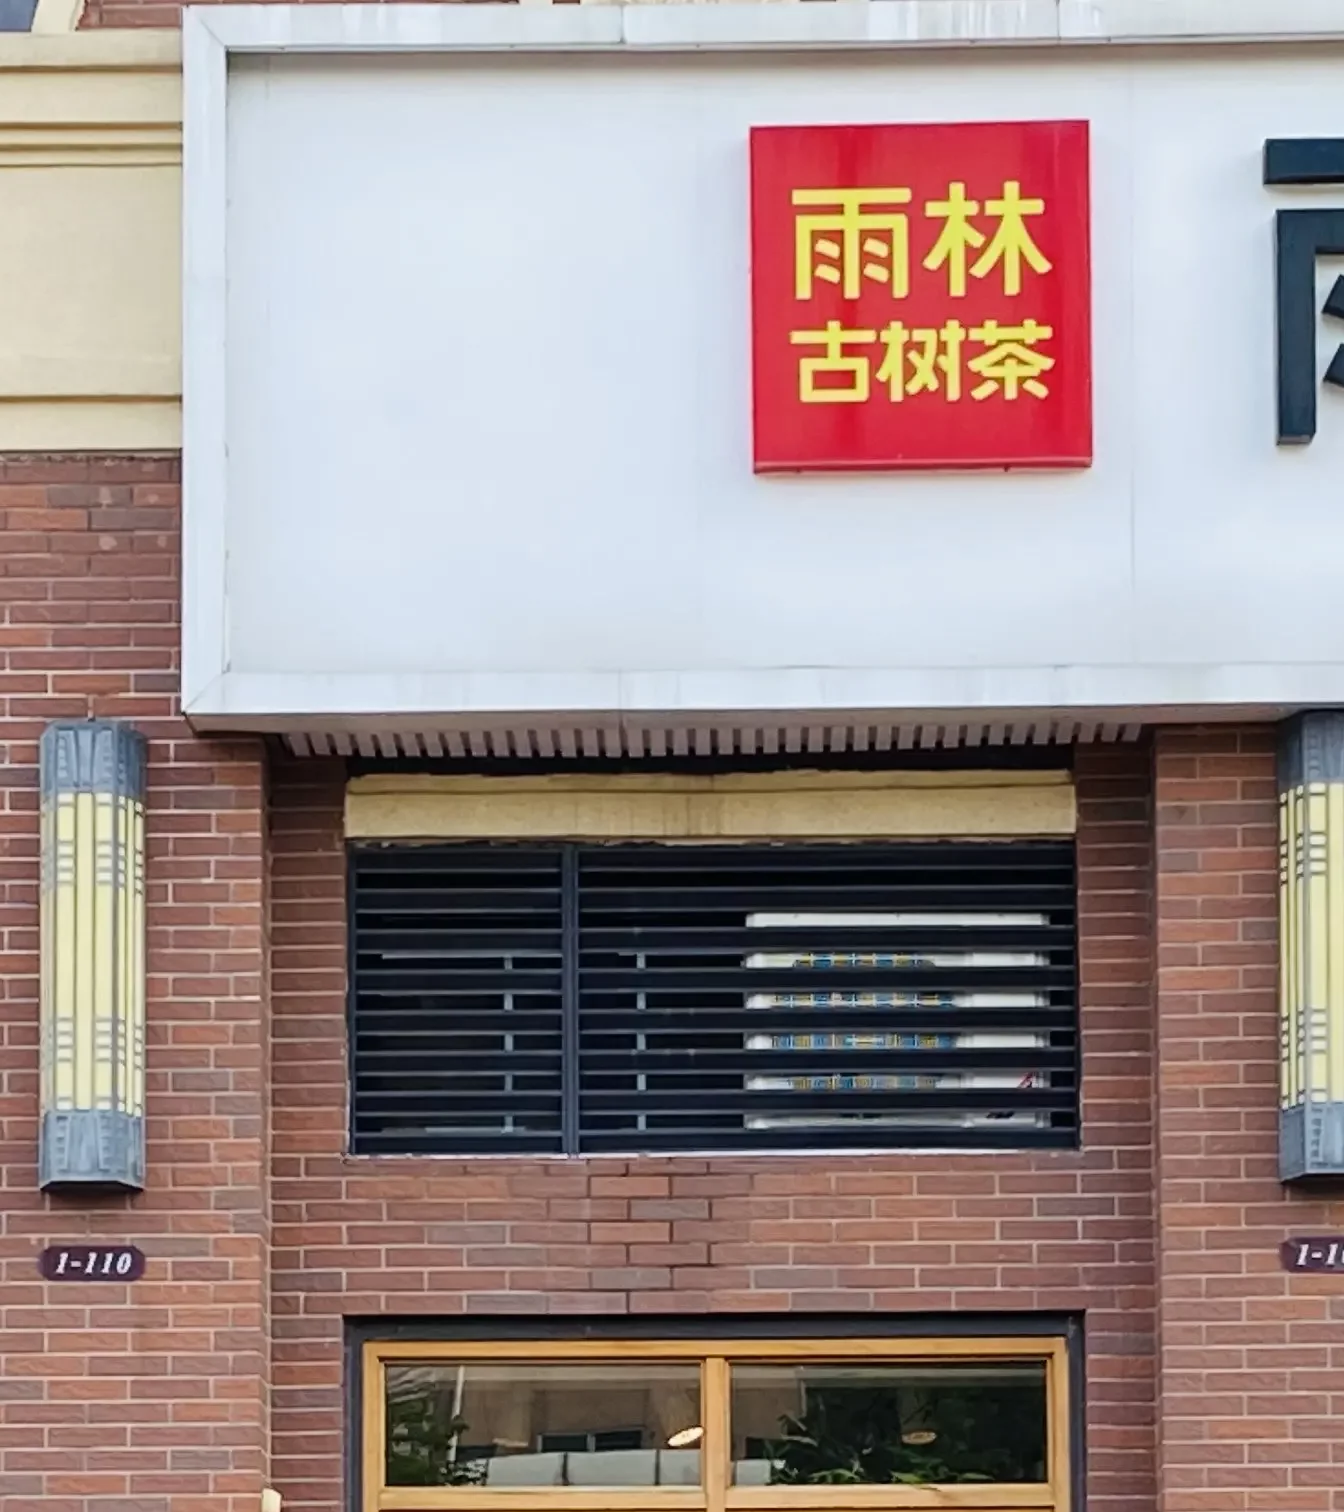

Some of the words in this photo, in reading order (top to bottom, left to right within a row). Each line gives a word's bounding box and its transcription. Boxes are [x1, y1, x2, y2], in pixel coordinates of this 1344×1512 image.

[791, 181, 1053, 300] 雨林
[789, 319, 1055, 402] 古树茶
[56, 1252, 132, 1275] 1-110
